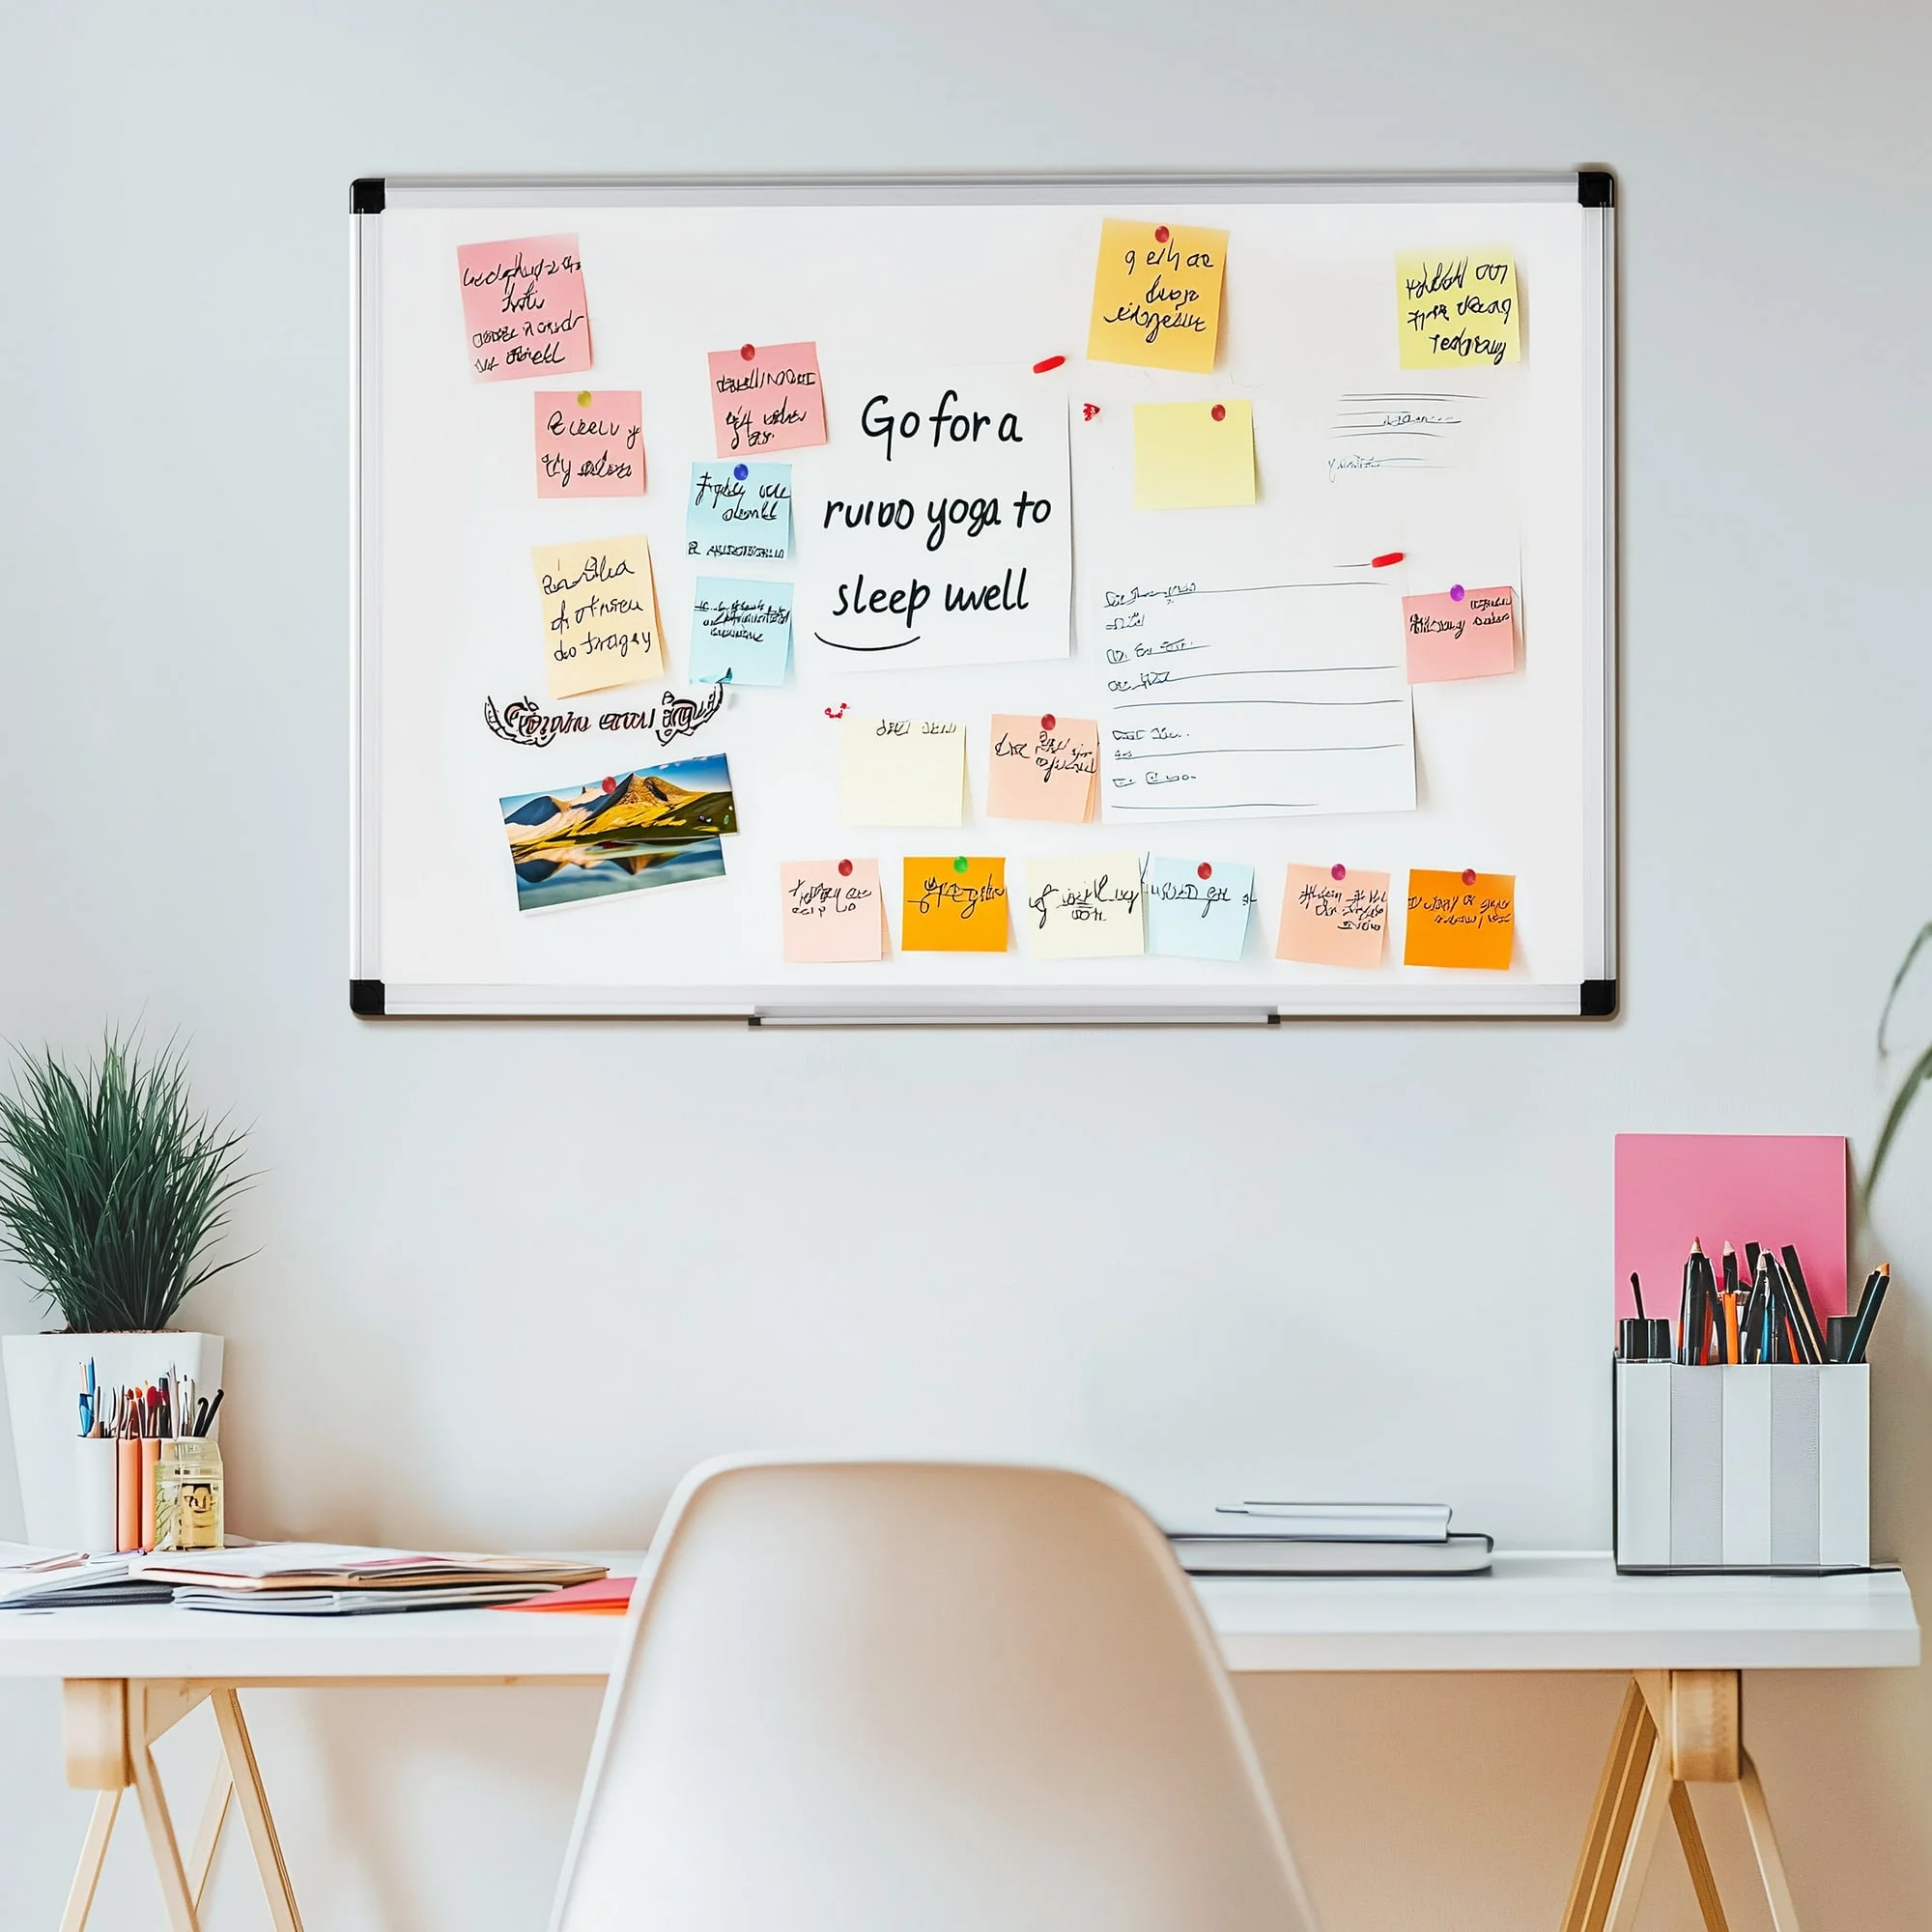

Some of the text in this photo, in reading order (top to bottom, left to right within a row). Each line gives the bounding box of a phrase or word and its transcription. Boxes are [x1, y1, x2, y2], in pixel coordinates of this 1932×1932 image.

[861, 389, 921, 462] Go
[928, 389, 991, 448] for
[997, 412, 1024, 442] a
[925, 497, 1002, 553] yoga
[1012, 490, 1052, 528] to
[832, 574, 931, 629] sleep
[944, 567, 1030, 612] well
